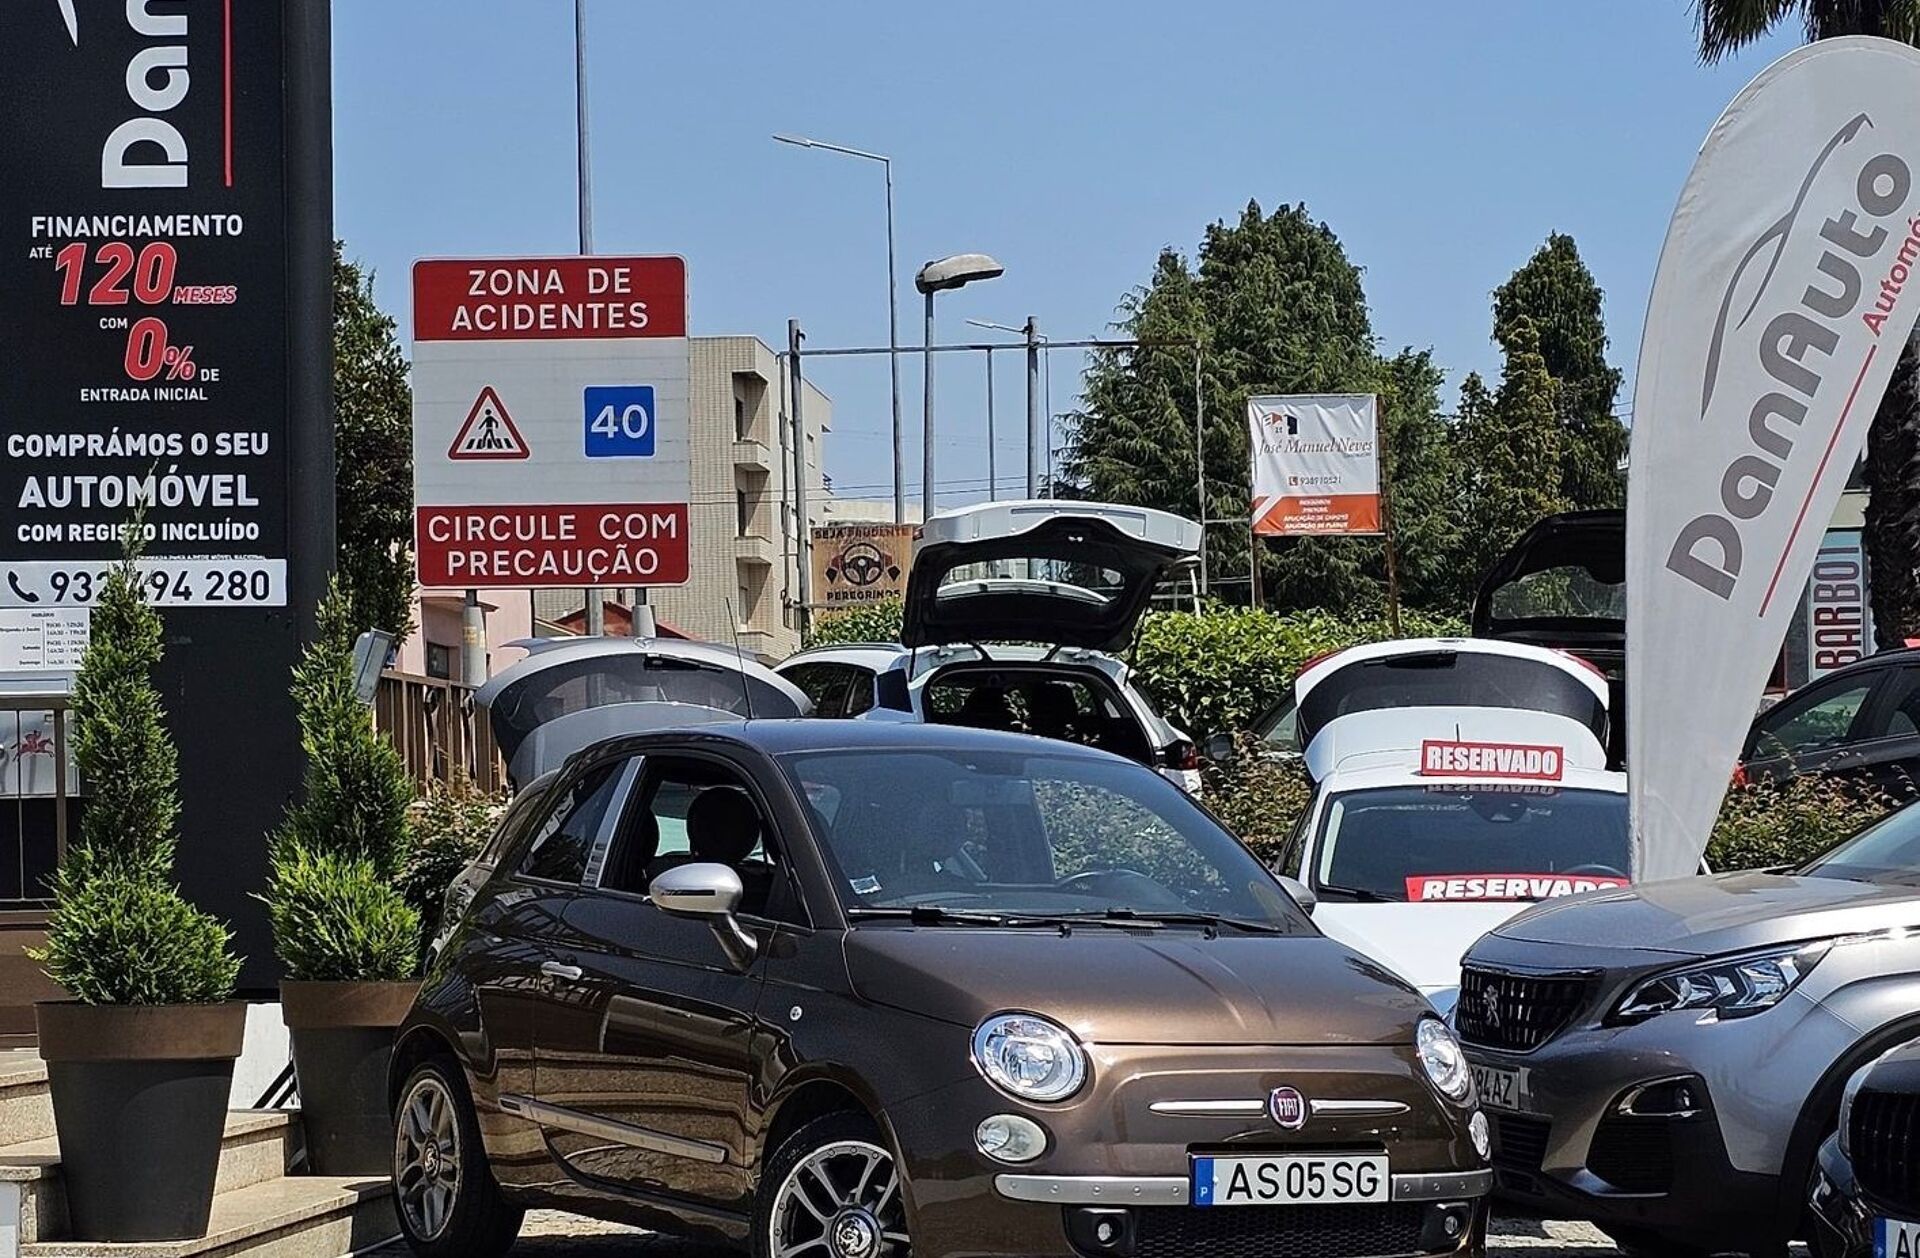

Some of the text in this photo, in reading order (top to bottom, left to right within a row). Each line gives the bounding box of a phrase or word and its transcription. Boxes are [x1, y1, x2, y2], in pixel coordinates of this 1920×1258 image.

[31, 214, 244, 238] FINANCIAMENTO
[29, 241, 237, 306] ATÉ 120 MESES
[468, 267, 631, 296] ZONA DE
[451, 301, 649, 331] ACIDENTES
[99, 316, 220, 382] COM 0% DE
[1666, 153, 1911, 601] DanAuto
[80, 387, 208, 402] ENTRADA INICIAL
[590, 404, 649, 439] 40
[7, 427, 269, 458] COMPRÁMOS O SEU
[1284, 437, 1335, 454] Manuel
[1337, 437, 1373, 453] Neves
[17, 464, 260, 509] AUTOMÓVEL
[17, 523, 62, 543] COM
[161, 517, 260, 542] INCLUÍDO
[428, 512, 676, 542] CIRCULE COM
[447, 543, 658, 583] PRECAUÇÃO
[205, 569, 270, 601] 280
[1426, 745, 1558, 775] RESERVADO
[1278, 1097, 1298, 1117] FIAT
[1200, 1187, 1208, 1198] P
